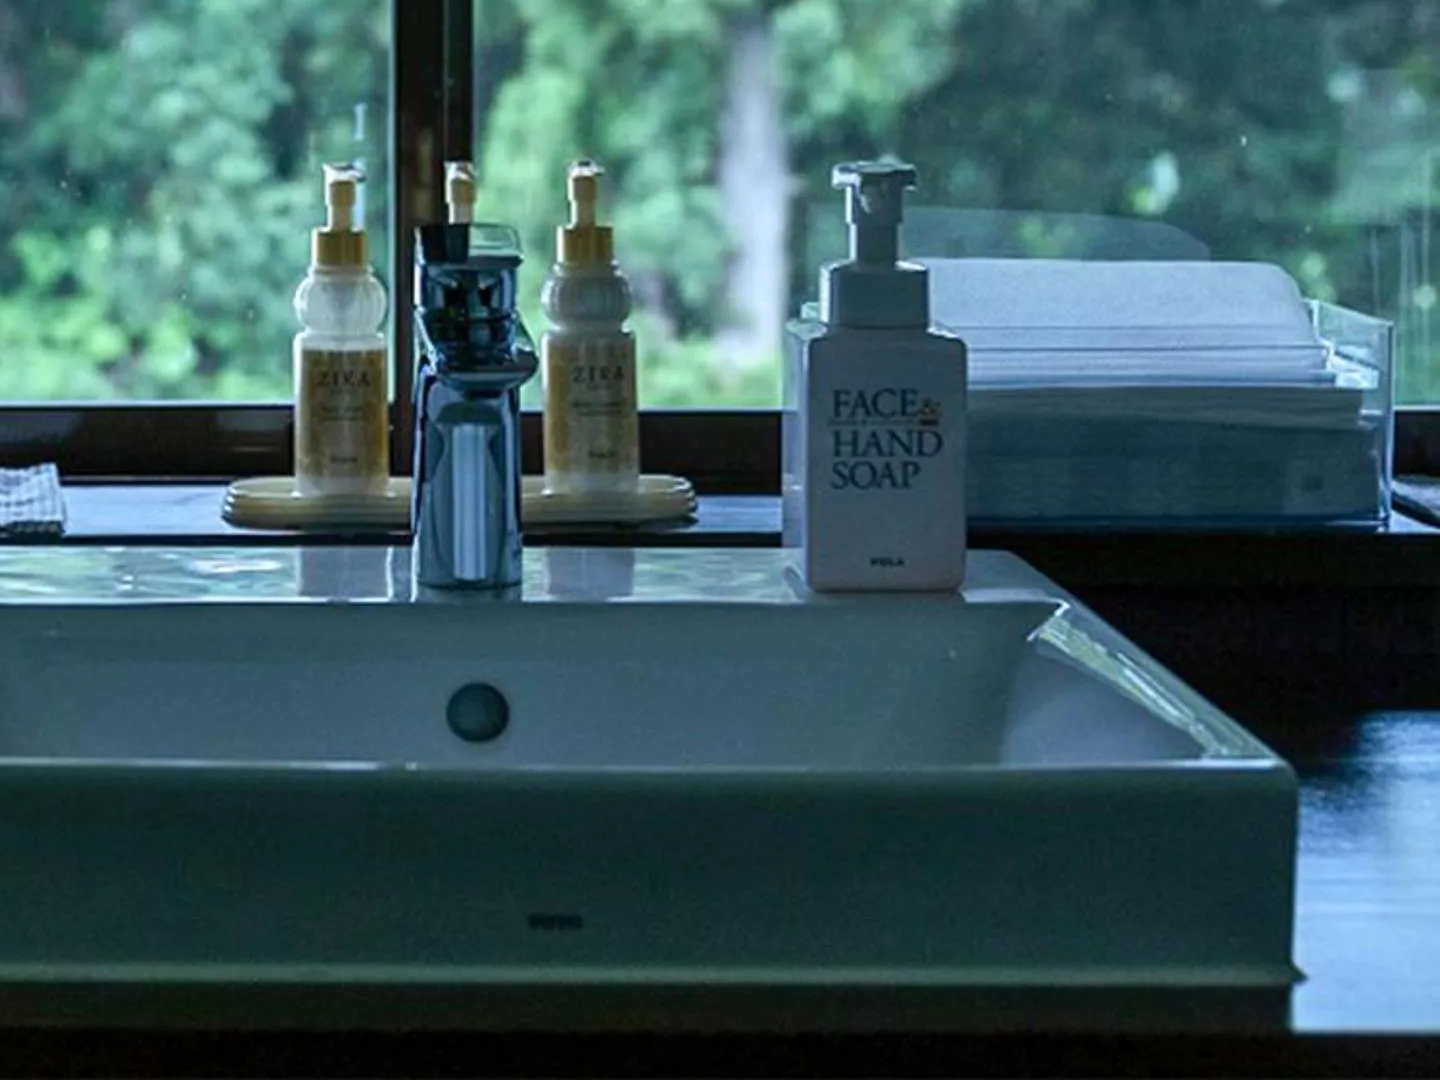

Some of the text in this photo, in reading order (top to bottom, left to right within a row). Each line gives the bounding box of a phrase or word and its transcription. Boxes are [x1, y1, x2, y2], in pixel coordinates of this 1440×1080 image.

[832, 388, 920, 418] FACE
[832, 429, 945, 459] HAND
[829, 460, 922, 491] SOAP
